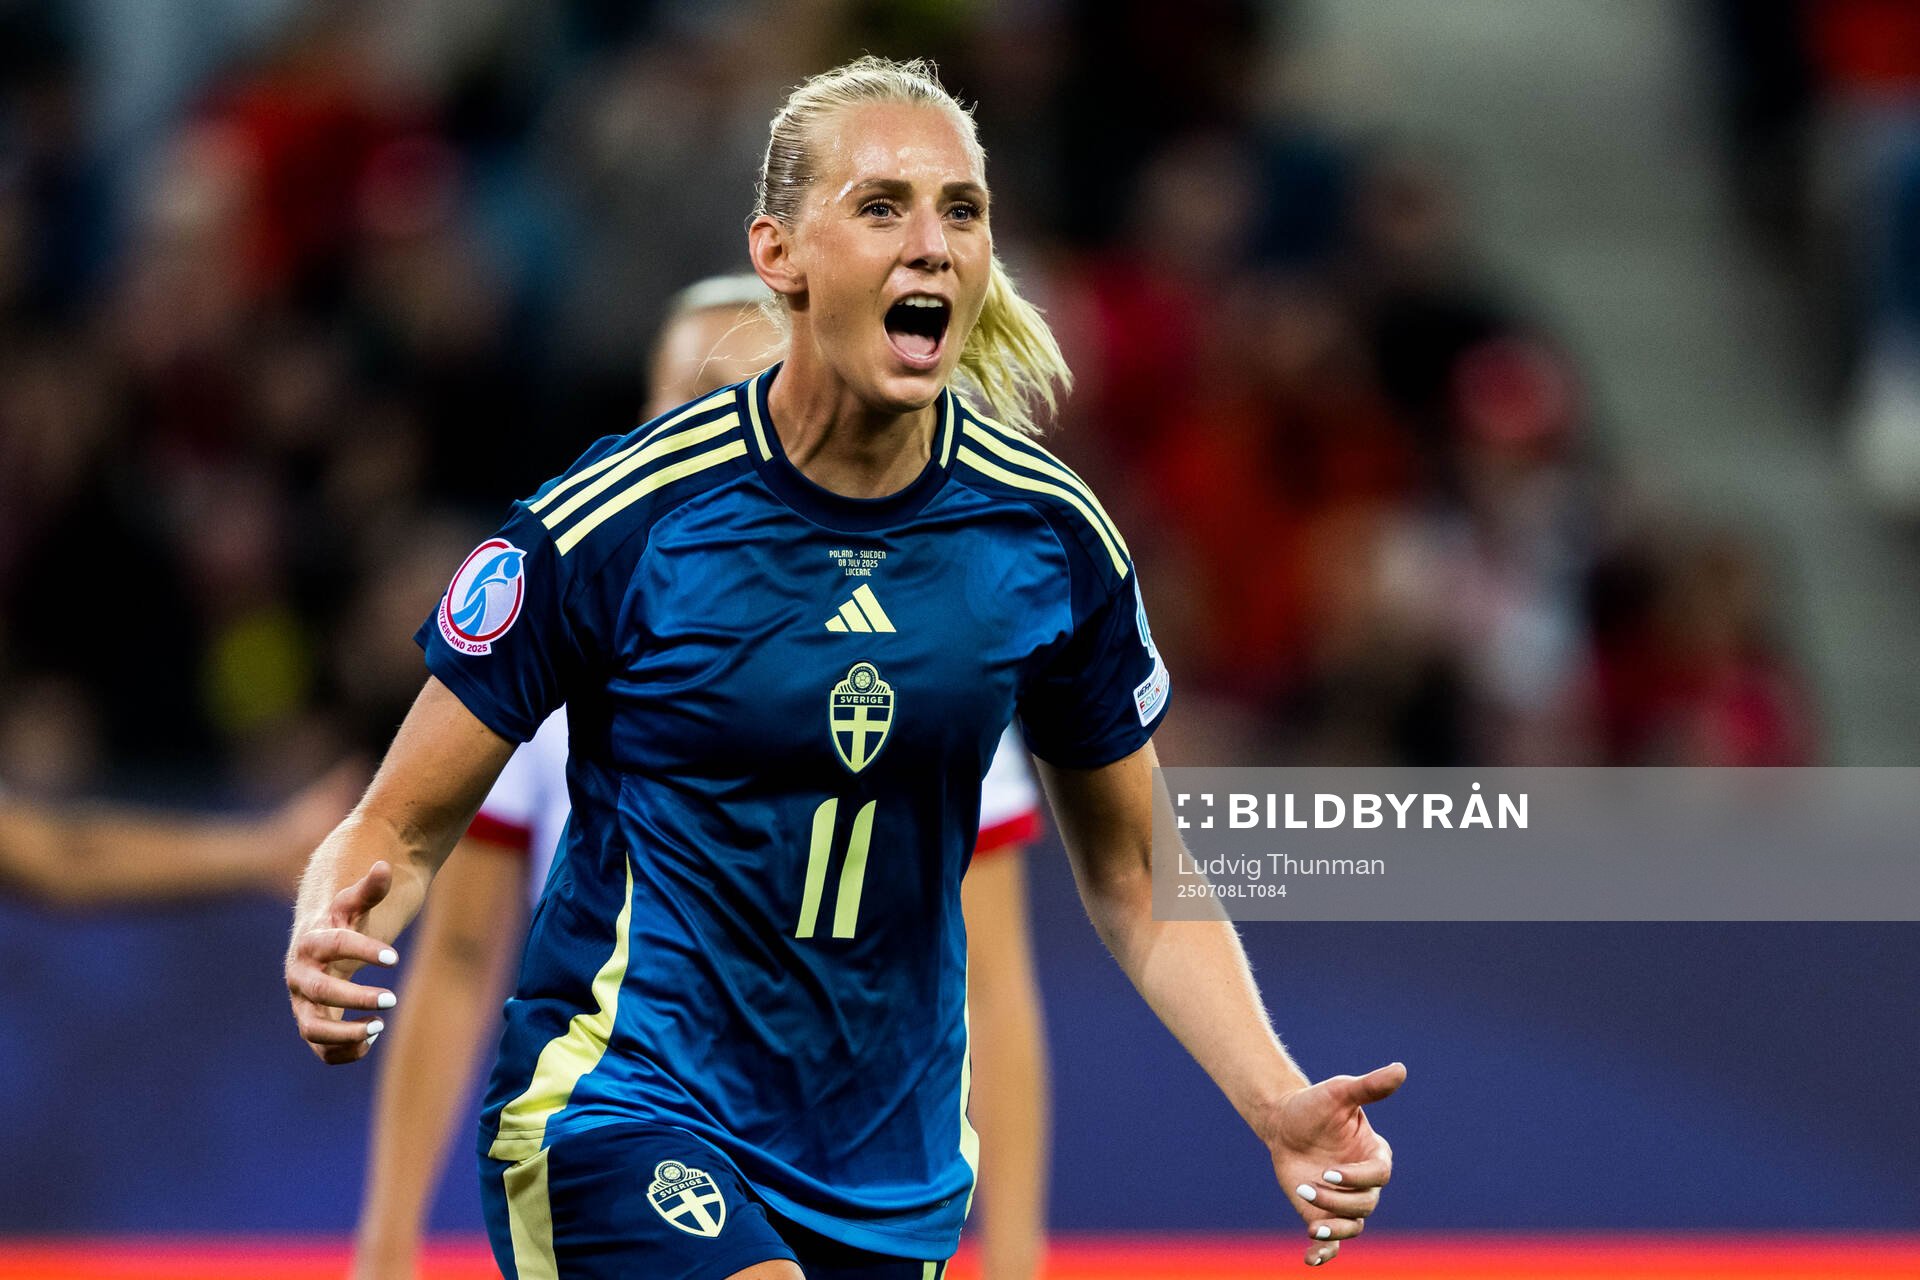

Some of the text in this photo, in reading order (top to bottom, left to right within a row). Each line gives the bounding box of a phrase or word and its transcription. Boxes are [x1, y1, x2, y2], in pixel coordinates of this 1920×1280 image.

[829, 550, 853, 558] POLAND
[860, 550, 886, 559] SWEDEN
[838, 559, 878, 568] 08 JULY 2025
[845, 568, 872, 576] LUCERNE
[466, 643, 488, 653] 2025
[1137, 682, 1151, 698] UEFA
[840, 695, 884, 704] SVERIGE
[795, 797, 877, 939] 11
[660, 1178, 703, 1198] SVERIGE
